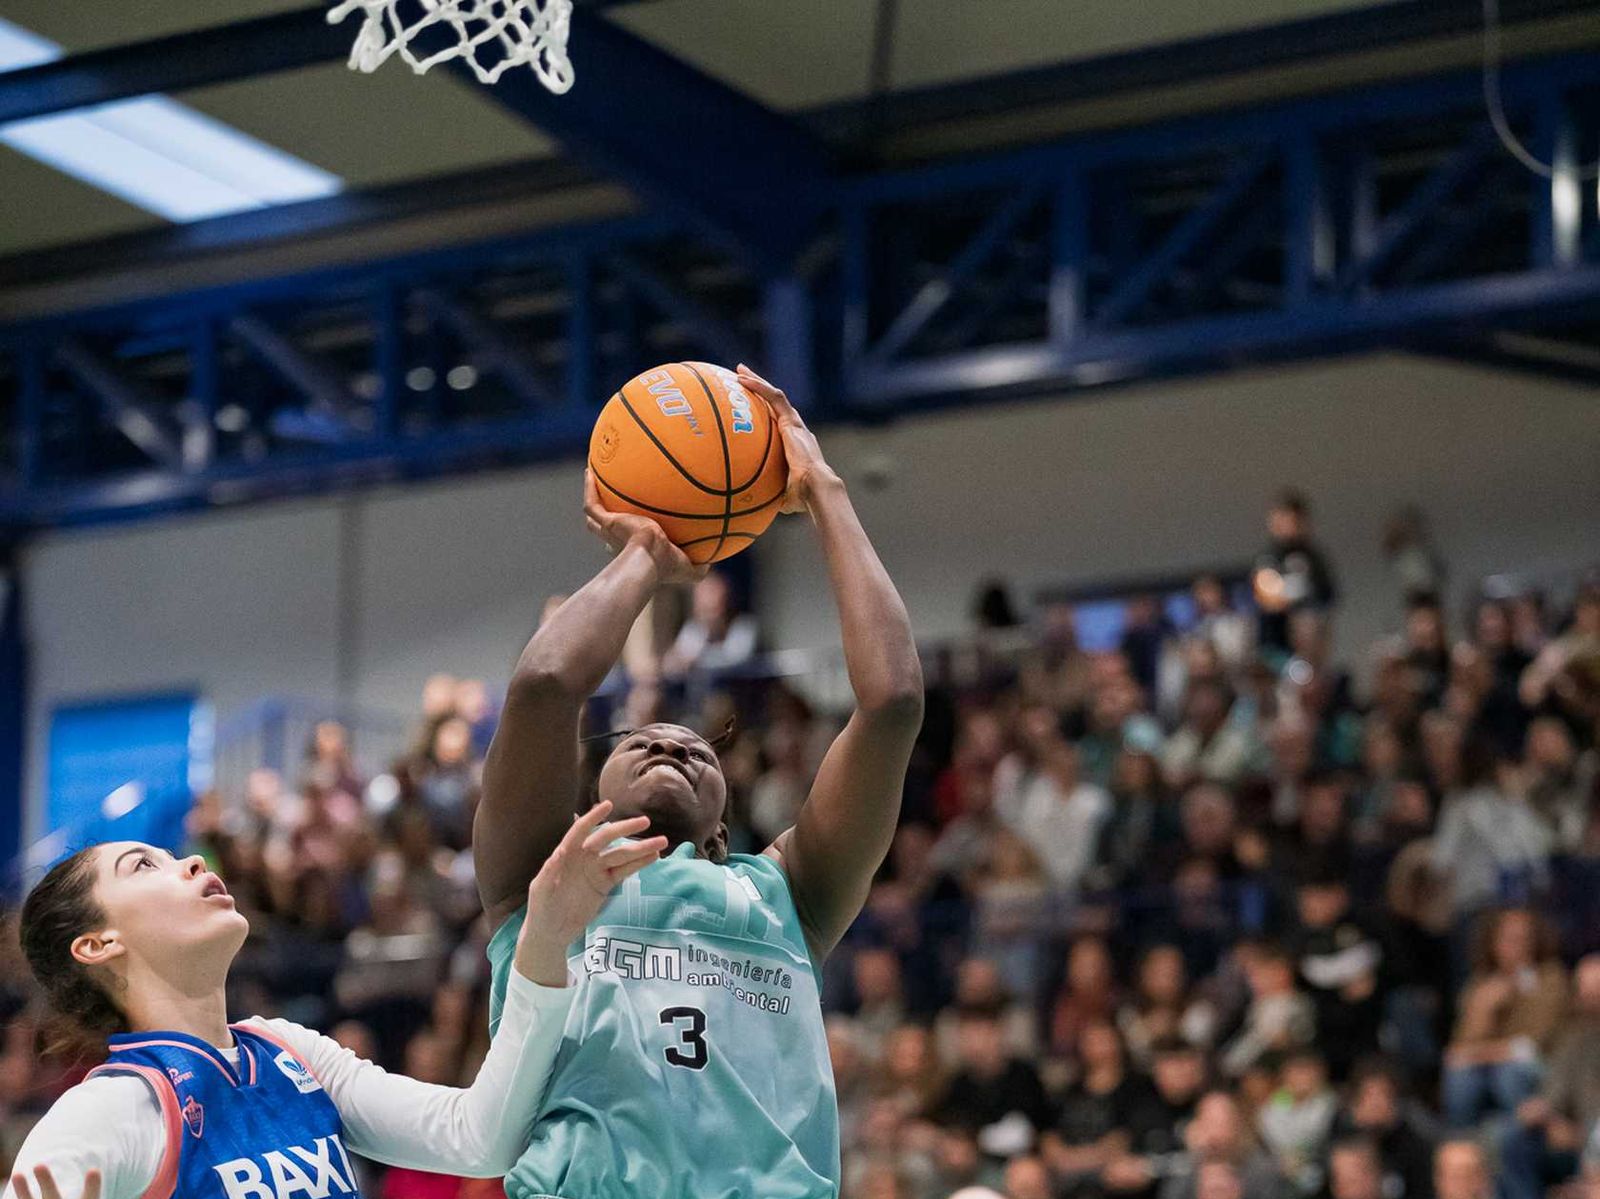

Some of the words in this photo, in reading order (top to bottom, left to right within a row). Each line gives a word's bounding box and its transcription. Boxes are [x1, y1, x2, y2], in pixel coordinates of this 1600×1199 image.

[639, 369, 693, 416] EVO
[687, 971, 790, 1015] ambental
[658, 1006, 709, 1072] 3
